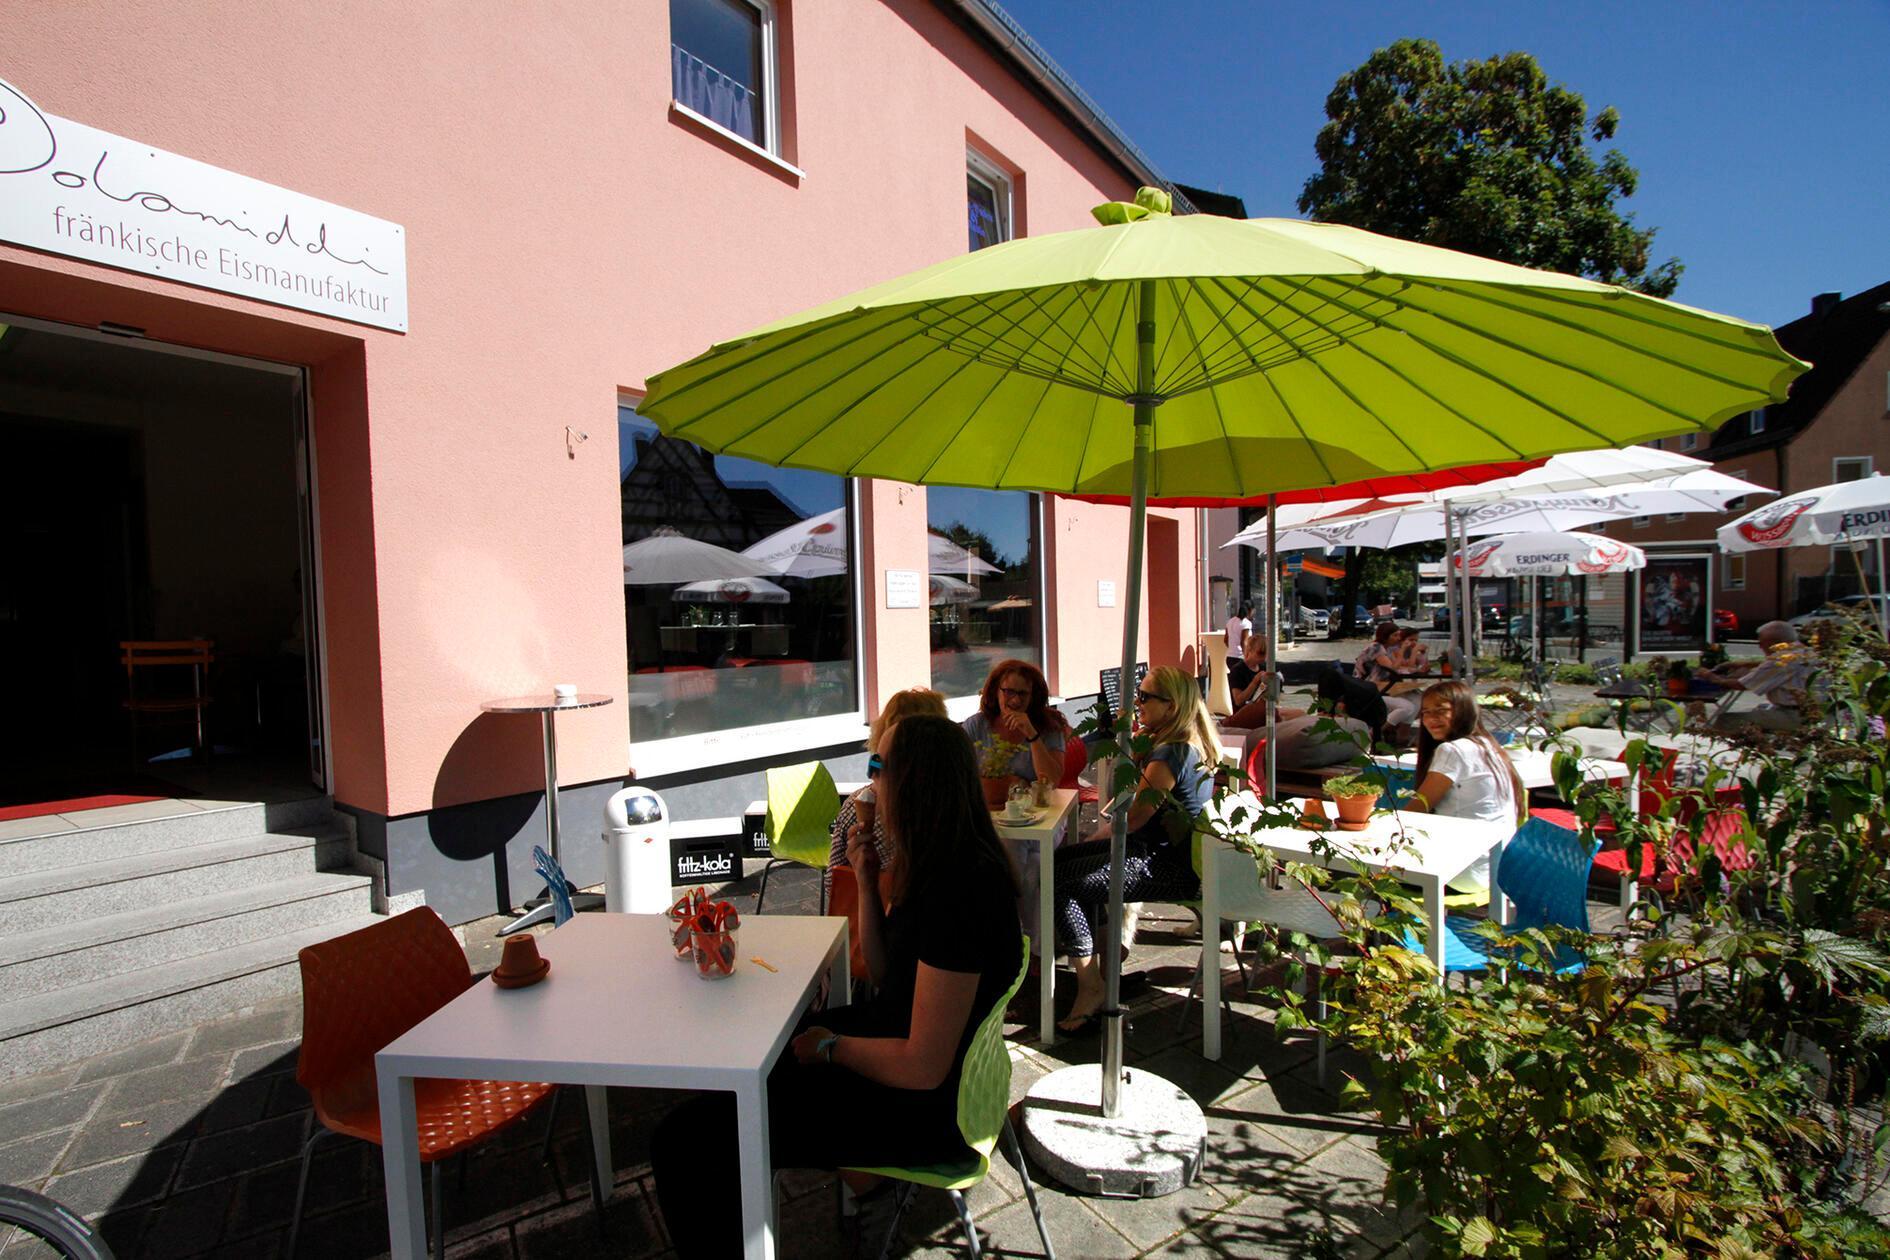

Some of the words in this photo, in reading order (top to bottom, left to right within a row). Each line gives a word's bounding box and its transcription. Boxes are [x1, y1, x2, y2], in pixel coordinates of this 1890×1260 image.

[52, 205, 209, 270] fränkische
[218, 247, 390, 314] Eismanufaktur
[1842, 508, 1890, 528] ERDI
[1516, 552, 1570, 565] ERDINGER
